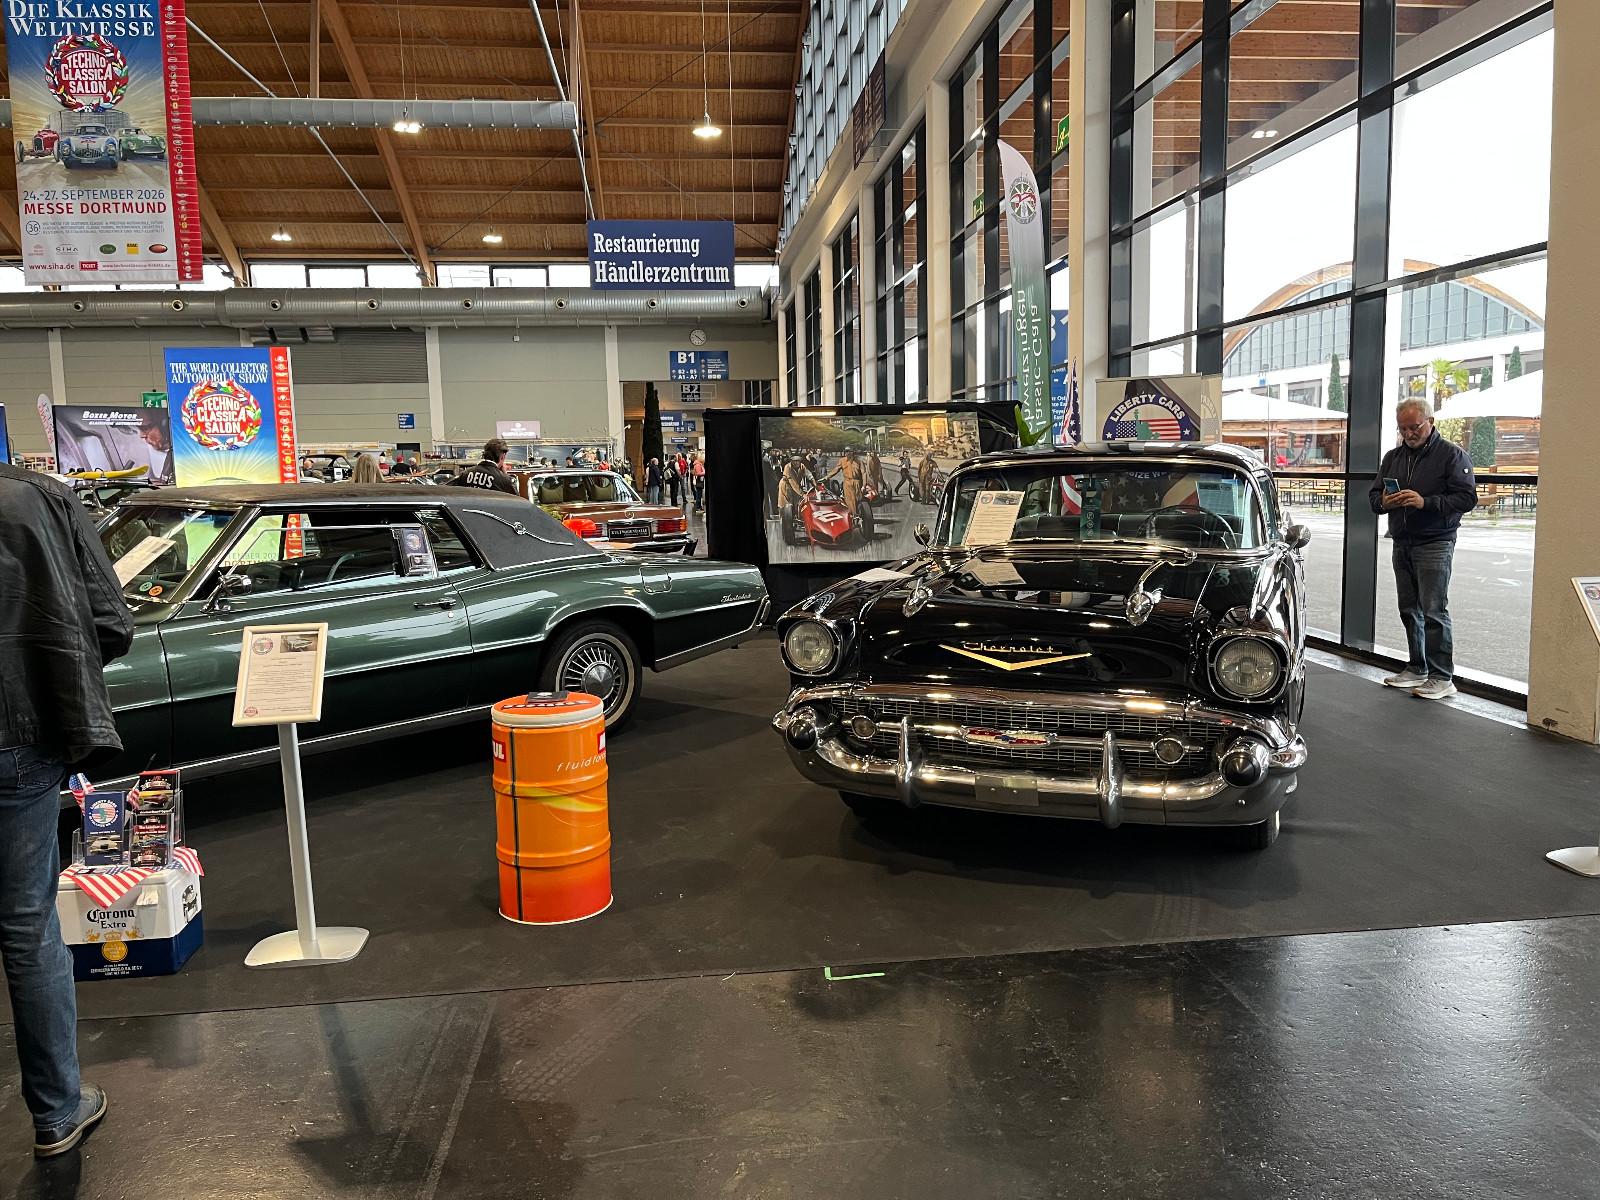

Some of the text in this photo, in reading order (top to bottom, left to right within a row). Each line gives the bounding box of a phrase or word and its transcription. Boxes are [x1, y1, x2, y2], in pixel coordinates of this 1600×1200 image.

[8, 0, 153, 18] DIE KLASSIK
[9, 18, 155, 37] WELTMESSE
[67, 53, 107, 69] TECHNO
[61, 63, 113, 81] CLASSICA
[69, 80, 107, 94] SALON
[23, 189, 165, 201] 24.-27. SEPTEMBER 2026
[24, 201, 167, 215] MESSE DORTMUND
[27, 223, 40, 233] 36
[593, 232, 700, 258] Restaurierung
[29, 262, 75, 270] www.siha.de
[594, 260, 730, 284] Händlerzentrum
[677, 352, 695, 363] B1
[170, 362, 268, 373] THE WORLD COLLECTOR
[171, 373, 268, 384] AUTOMOBILE SHOW
[202, 398, 241, 410] TECHNO
[1109, 394, 1185, 423] LIBERTY CARS
[196, 406, 247, 422] CLASSICA
[204, 421, 241, 434] SALON
[466, 471, 494, 488] DEUS
[87, 908, 135, 922] Corona
[101, 920, 127, 929] Extra
